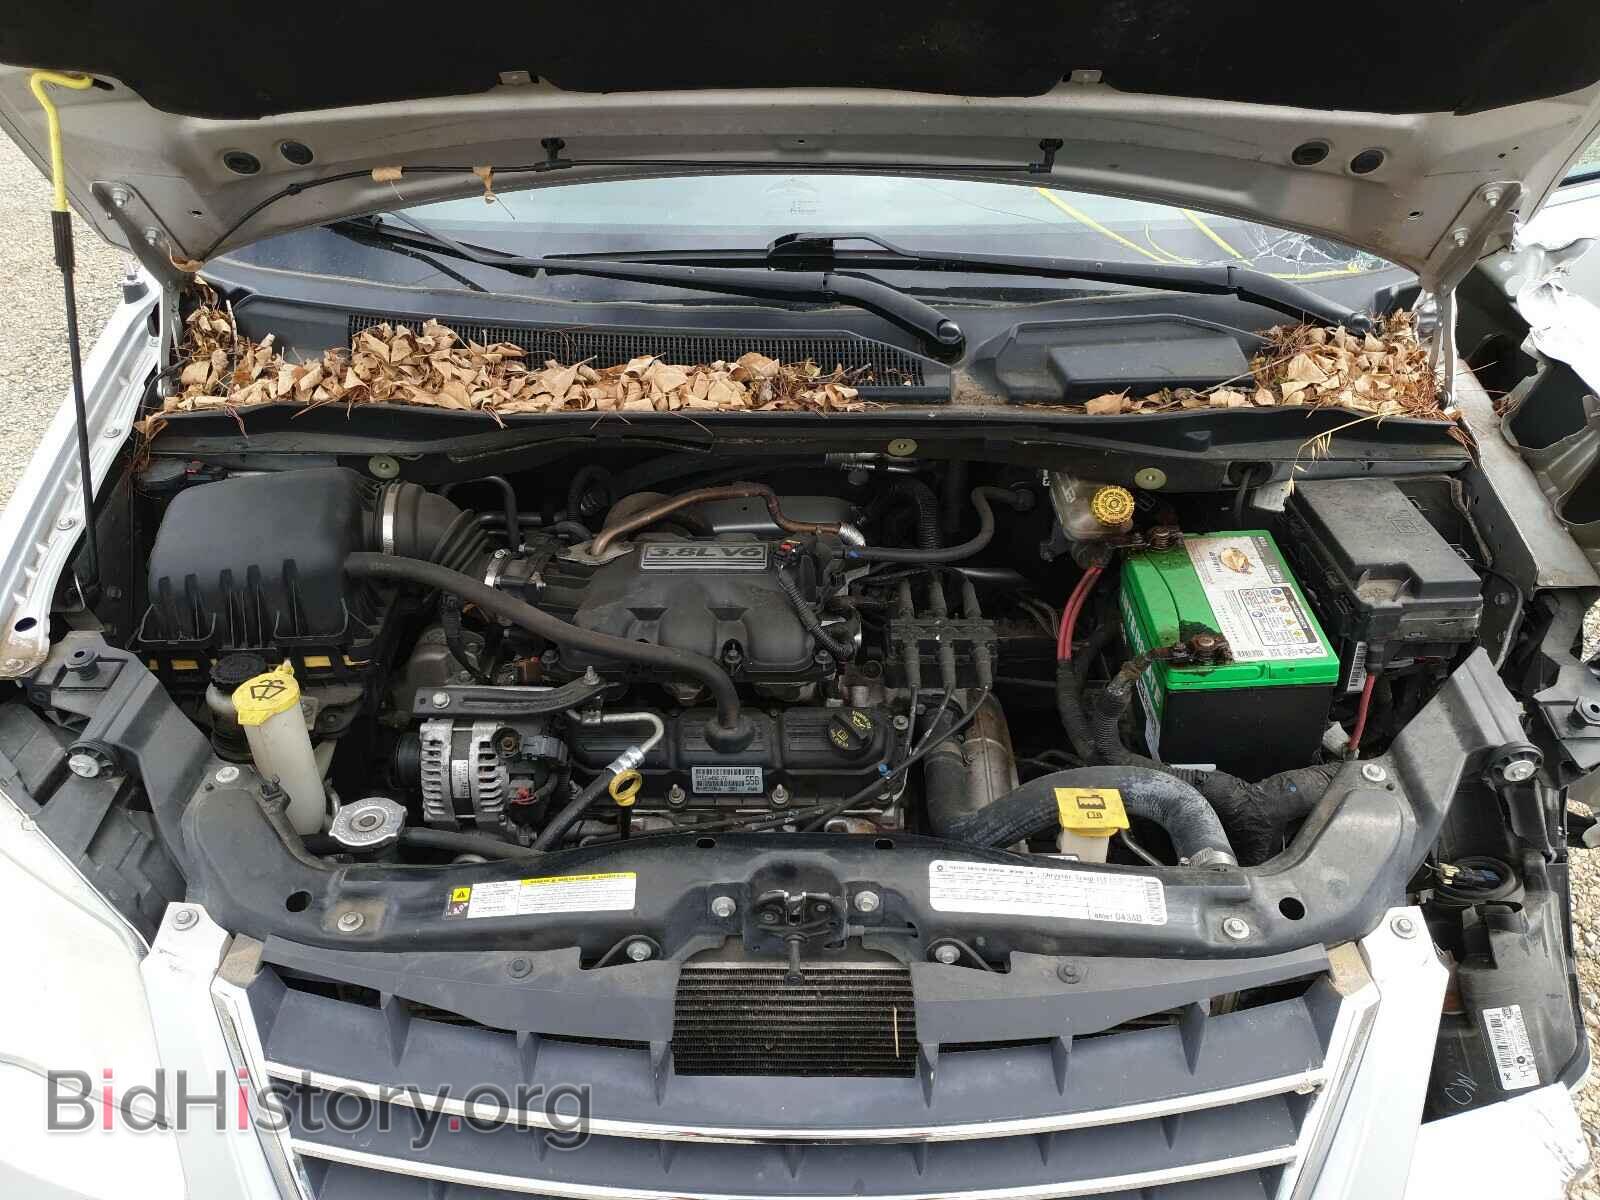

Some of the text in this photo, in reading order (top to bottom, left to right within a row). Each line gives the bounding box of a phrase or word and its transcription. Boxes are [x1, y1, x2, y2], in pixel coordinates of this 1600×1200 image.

[649, 547, 762, 557] 3.8L V6
[1120, 587, 1160, 707] INTERSATE
